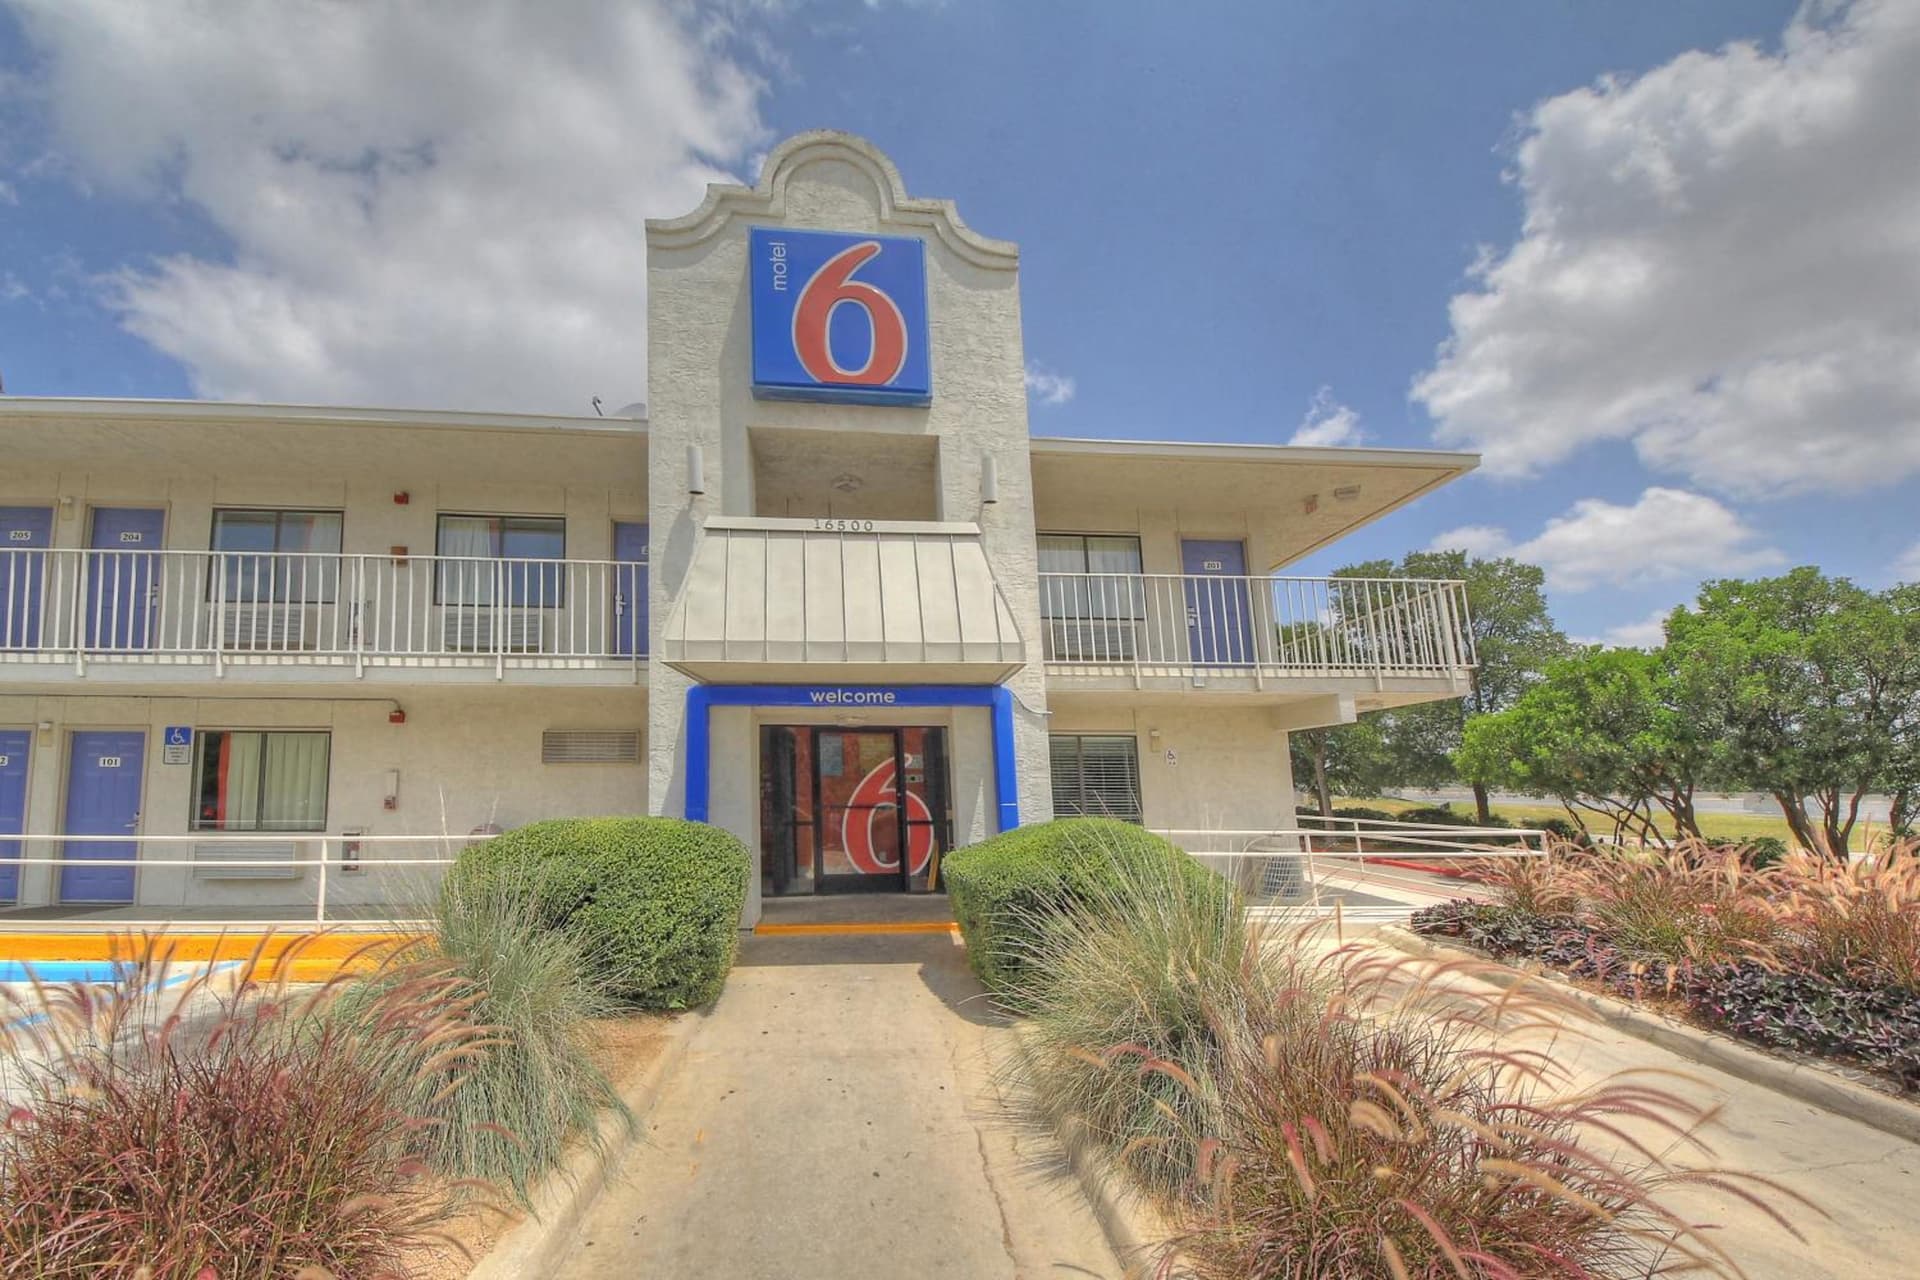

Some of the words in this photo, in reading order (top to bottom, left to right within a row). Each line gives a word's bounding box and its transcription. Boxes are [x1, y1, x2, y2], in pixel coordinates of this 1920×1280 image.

[768, 242, 788, 291] motel
[791, 240, 908, 386] 6
[814, 519, 873, 532] 16500
[12, 531, 29, 539] 205
[122, 533, 140, 541] 204
[810, 688, 895, 704] welcome
[102, 758, 119, 767] 101
[842, 753, 934, 876] 6
